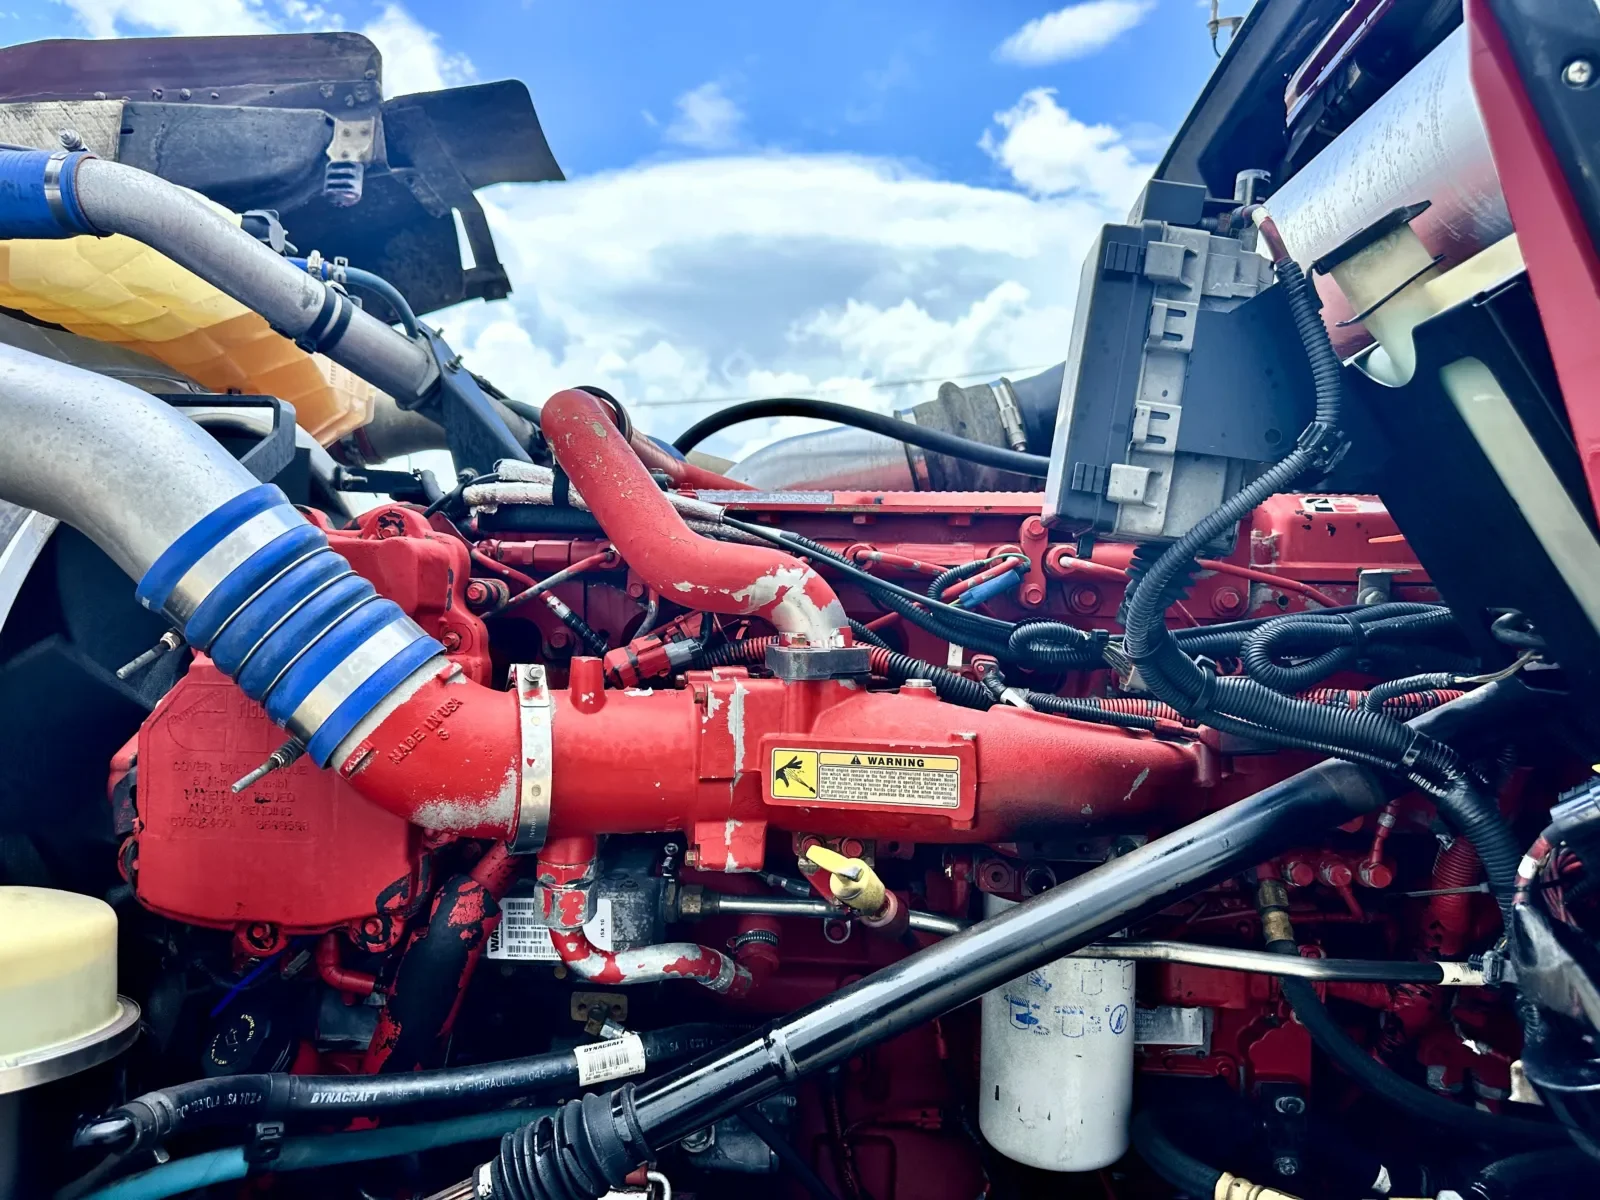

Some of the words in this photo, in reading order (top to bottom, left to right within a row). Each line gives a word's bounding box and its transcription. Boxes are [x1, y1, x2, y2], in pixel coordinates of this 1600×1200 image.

[388, 728, 426, 764] MADE
[424, 712, 444, 732] IN
[436, 698, 464, 718] USA
[172, 761, 212, 772] COVER
[868, 756, 925, 768] WARNING
[254, 792, 296, 803] ISSUED
[240, 805, 292, 816] PENDING
[584, 1040, 624, 1052] DYNACRAFT
[310, 1090, 380, 1104] DYNACRAFT
[469, 1075, 516, 1092] HYDRAULIC
